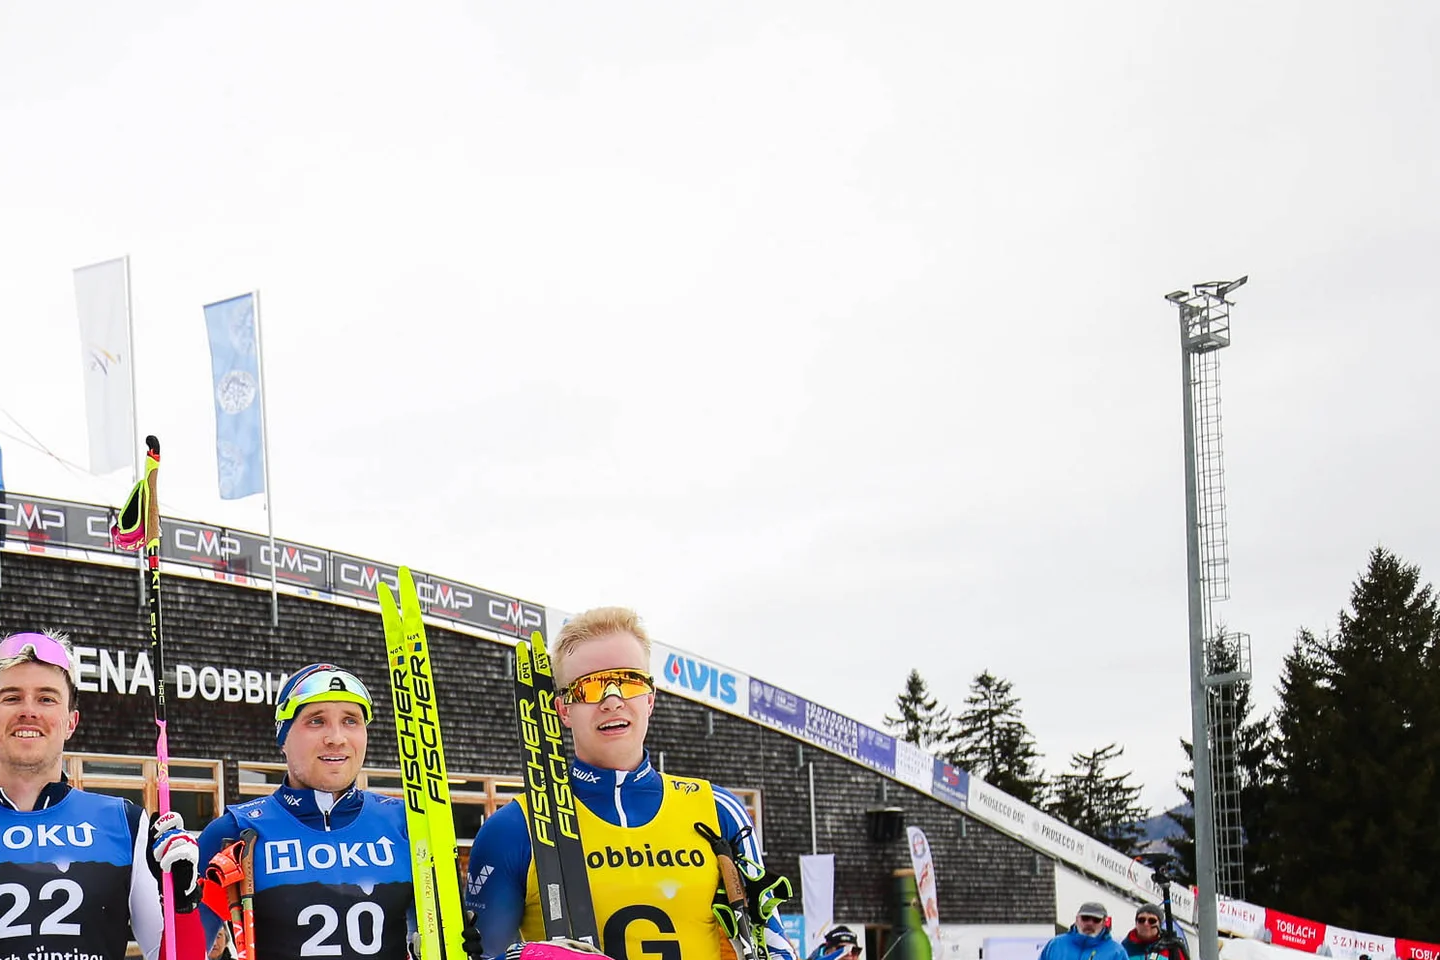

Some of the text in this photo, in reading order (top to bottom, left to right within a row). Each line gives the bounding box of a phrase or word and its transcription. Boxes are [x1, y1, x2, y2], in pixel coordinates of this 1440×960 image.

[175, 529, 240, 556] CMP
[488, 599, 542, 627] CMP
[72, 646, 156, 697] ENA
[176, 664, 290, 706] DOBBI
[663, 653, 738, 705] AVIS
[393, 668, 425, 815] FISCHER
[410, 655, 446, 805] FISCHER
[519, 698, 555, 848] FISCHER
[538, 689, 579, 840] FISCHER
[265, 835, 396, 875] HOKU
[586, 843, 706, 869] obbiaco
[296, 901, 385, 957] 20
